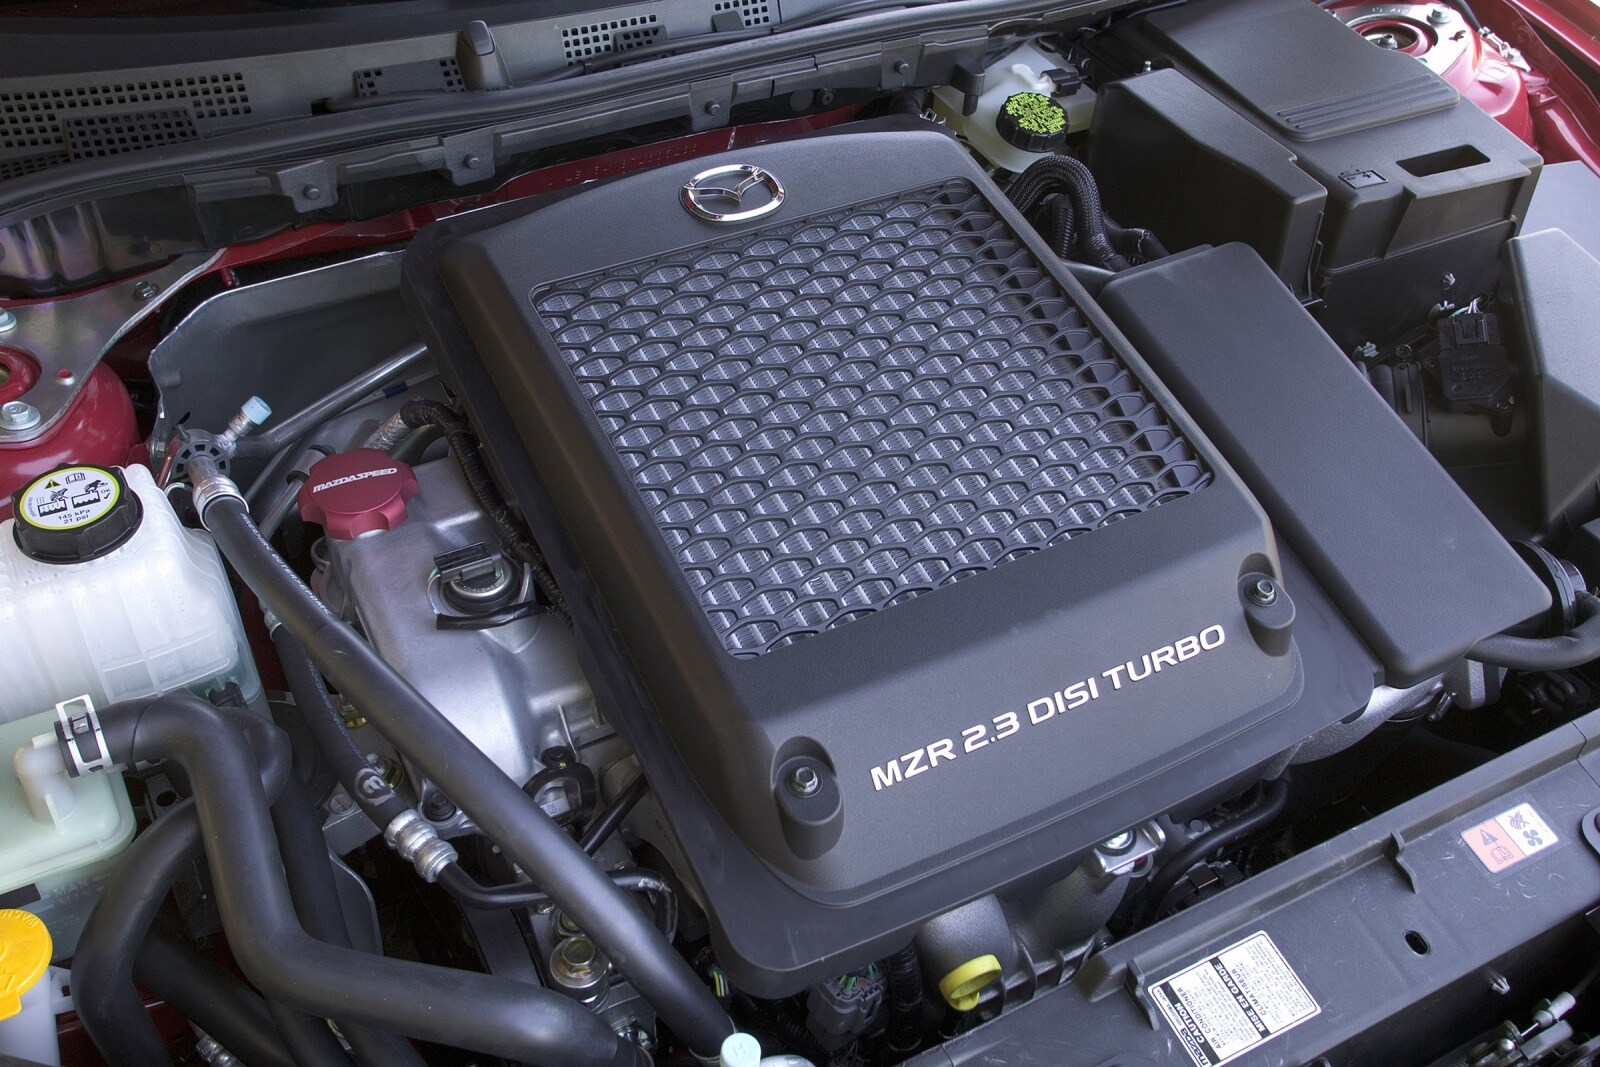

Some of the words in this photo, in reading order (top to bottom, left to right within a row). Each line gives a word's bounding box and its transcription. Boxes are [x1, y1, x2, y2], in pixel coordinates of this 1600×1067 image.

[312, 467, 398, 494] MAZDASPEED
[74, 509, 90, 517] kPa
[870, 737, 957, 791] MZR
[961, 711, 1020, 754] 2.3
[1027, 676, 1100, 726] DISI
[1102, 624, 1226, 691] TURBO
[1214, 962, 1239, 994] GARDE
[1231, 968, 1266, 1016] CLIMATISEUR
[1176, 986, 1211, 1033] CONDITIONER
[1236, 994, 1249, 1008] EN
[1174, 1003, 1206, 1043] CAUTION
[1246, 1008, 1265, 1032] MISE
[1209, 1036, 1221, 1049] AIR
